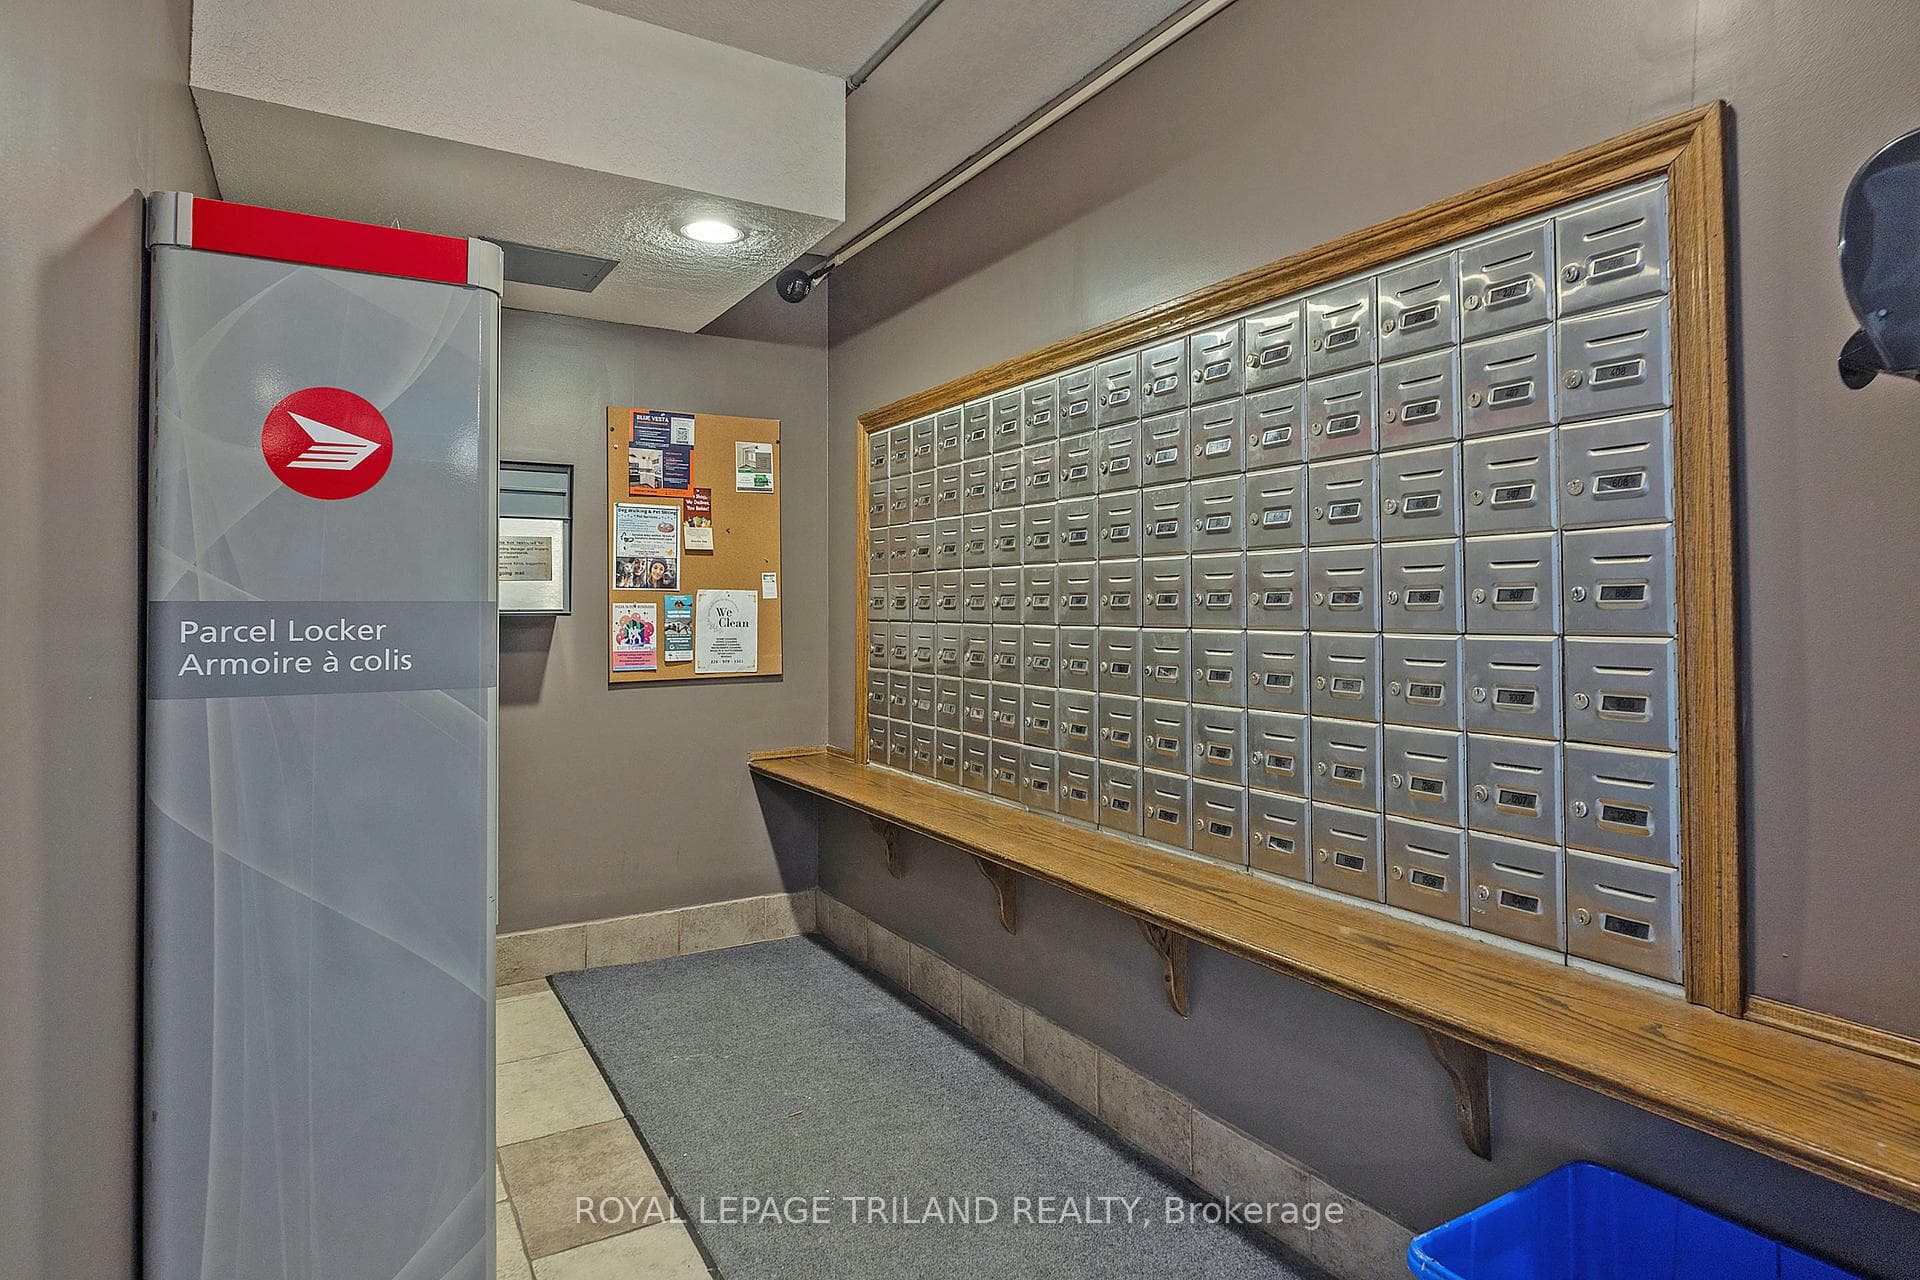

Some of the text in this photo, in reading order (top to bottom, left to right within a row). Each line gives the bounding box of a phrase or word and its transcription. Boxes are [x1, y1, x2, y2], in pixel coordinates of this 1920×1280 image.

[1609, 366, 1627, 377] 408
[651, 415, 669, 423] VESTA
[1610, 477, 1628, 489] 608
[716, 607, 733, 617] We
[718, 617, 749, 628] Clean
[179, 617, 388, 644] Parcel Locker
[177, 648, 414, 677] Armoire à colis
